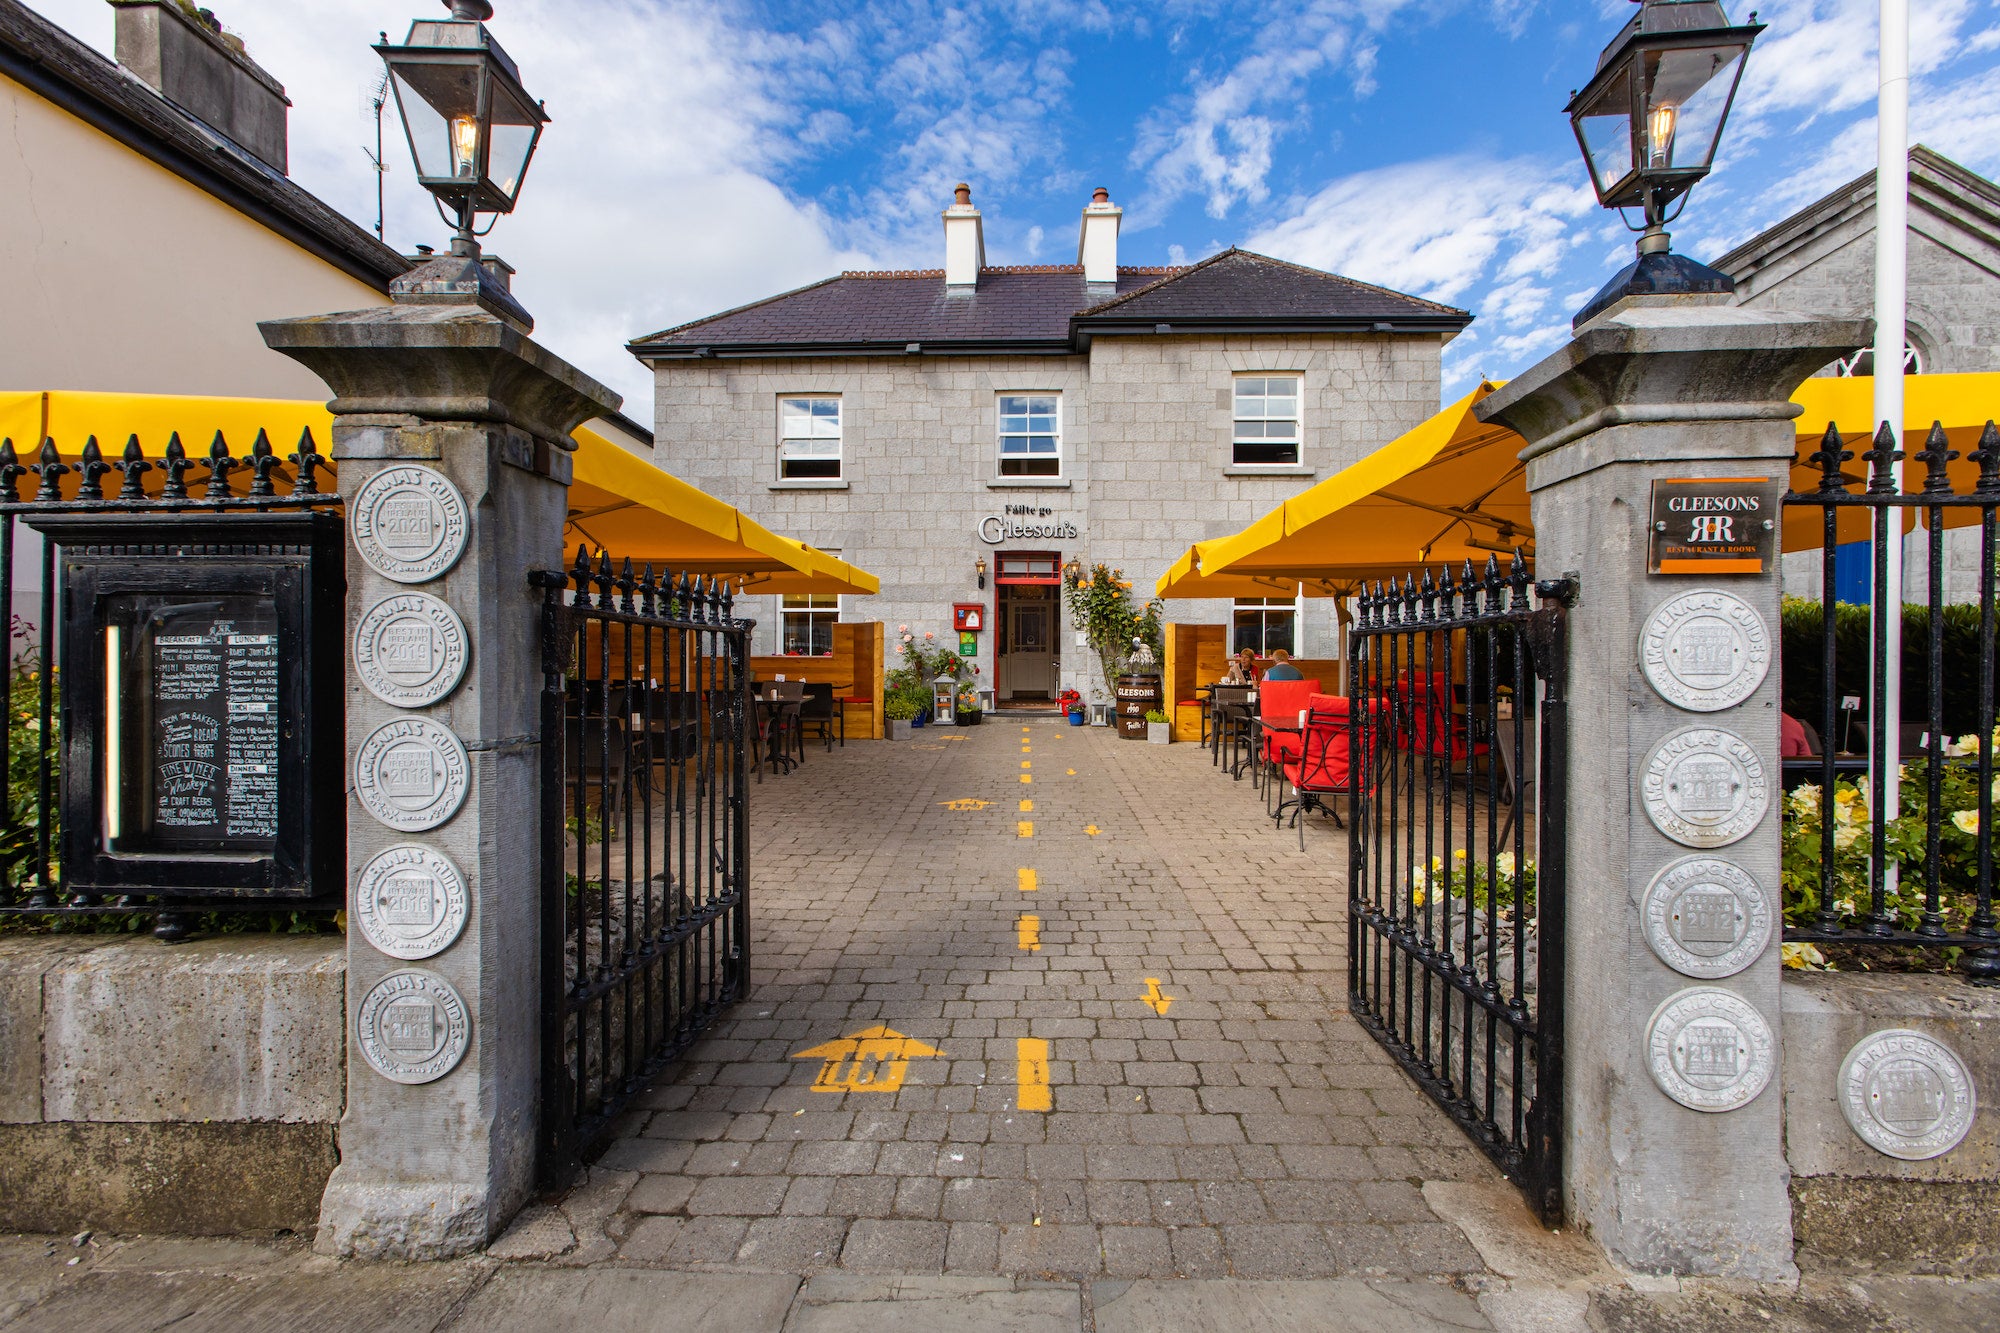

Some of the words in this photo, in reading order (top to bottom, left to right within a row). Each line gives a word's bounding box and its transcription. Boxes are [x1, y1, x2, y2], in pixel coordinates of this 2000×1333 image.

[429, 480, 462, 536] GUIDES
[1005, 504, 1036, 514] Fáilte
[1038, 507, 1052, 516] go
[1667, 496, 1760, 512] GLEESONS
[386, 509, 428, 518] IRELAND
[388, 518, 429, 534] 2020
[977, 514, 1078, 544] Gleeson's
[159, 635, 200, 644] BREAKFAST
[388, 628, 414, 636] BEST
[417, 628, 429, 636] IN
[388, 635, 428, 643] IRELAND
[431, 608, 461, 663] GUIDES
[1729, 606, 1765, 664] GUIDES
[389, 643, 428, 660] 2019
[1684, 646, 1730, 662] 2014
[1118, 688, 1155, 697] GLEESONS
[160, 714, 179, 728] FROM
[191, 712, 221, 728] BAKERY
[389, 760, 430, 768] IRELAND
[431, 732, 463, 786] GUIDES
[161, 762, 181, 778] FINE
[183, 761, 215, 777] WINES
[390, 768, 430, 785] 2018
[1728, 742, 1765, 800] GUIDES
[171, 797, 190, 806] CRAFT
[192, 797, 213, 806] BEERS
[158, 809, 176, 817] PHONE
[432, 860, 463, 915] GUIDES
[390, 896, 430, 913] 2016
[1650, 888, 1671, 926] THE
[1662, 864, 1766, 929] BRIDGESTONE
[1687, 912, 1732, 930] 2012
[433, 985, 464, 1040] GUIDES
[391, 1022, 431, 1039] 2015
[1651, 1018, 1674, 1059] THE
[1847, 1066, 1866, 1109] THE
[1857, 1040, 1968, 1105] BRIDGESTONE
